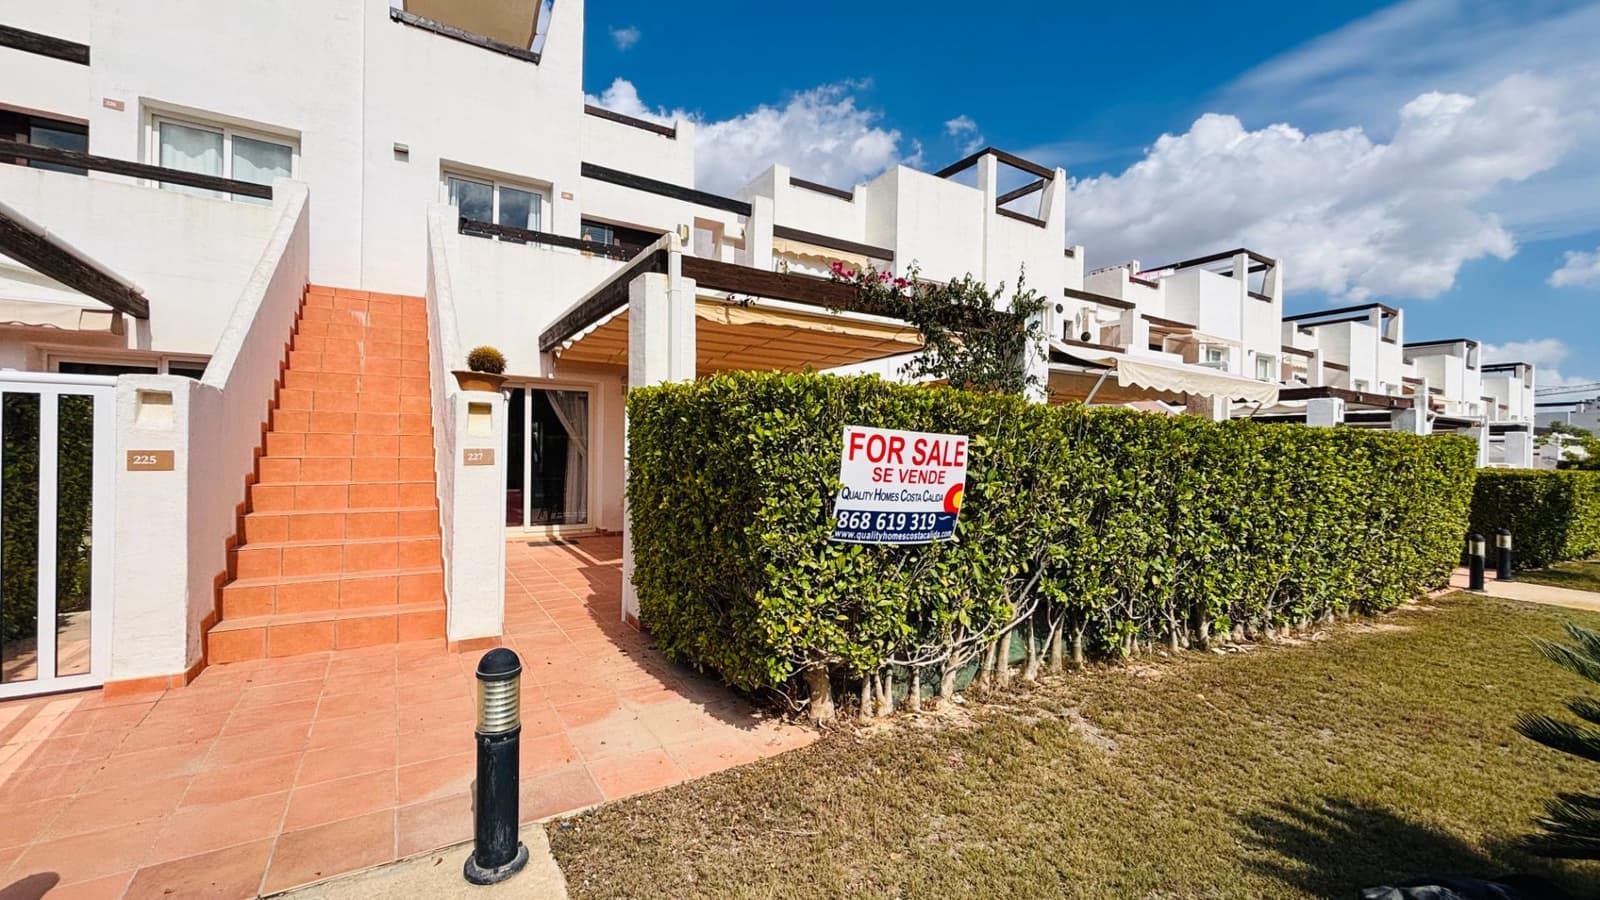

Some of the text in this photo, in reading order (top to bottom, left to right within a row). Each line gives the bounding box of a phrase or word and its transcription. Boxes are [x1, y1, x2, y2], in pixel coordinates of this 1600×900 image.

[849, 432, 965, 466] FOR SALE
[133, 455, 157, 464] 225
[872, 467, 946, 485] SE VENDE
[837, 511, 936, 531] 868 619 319
